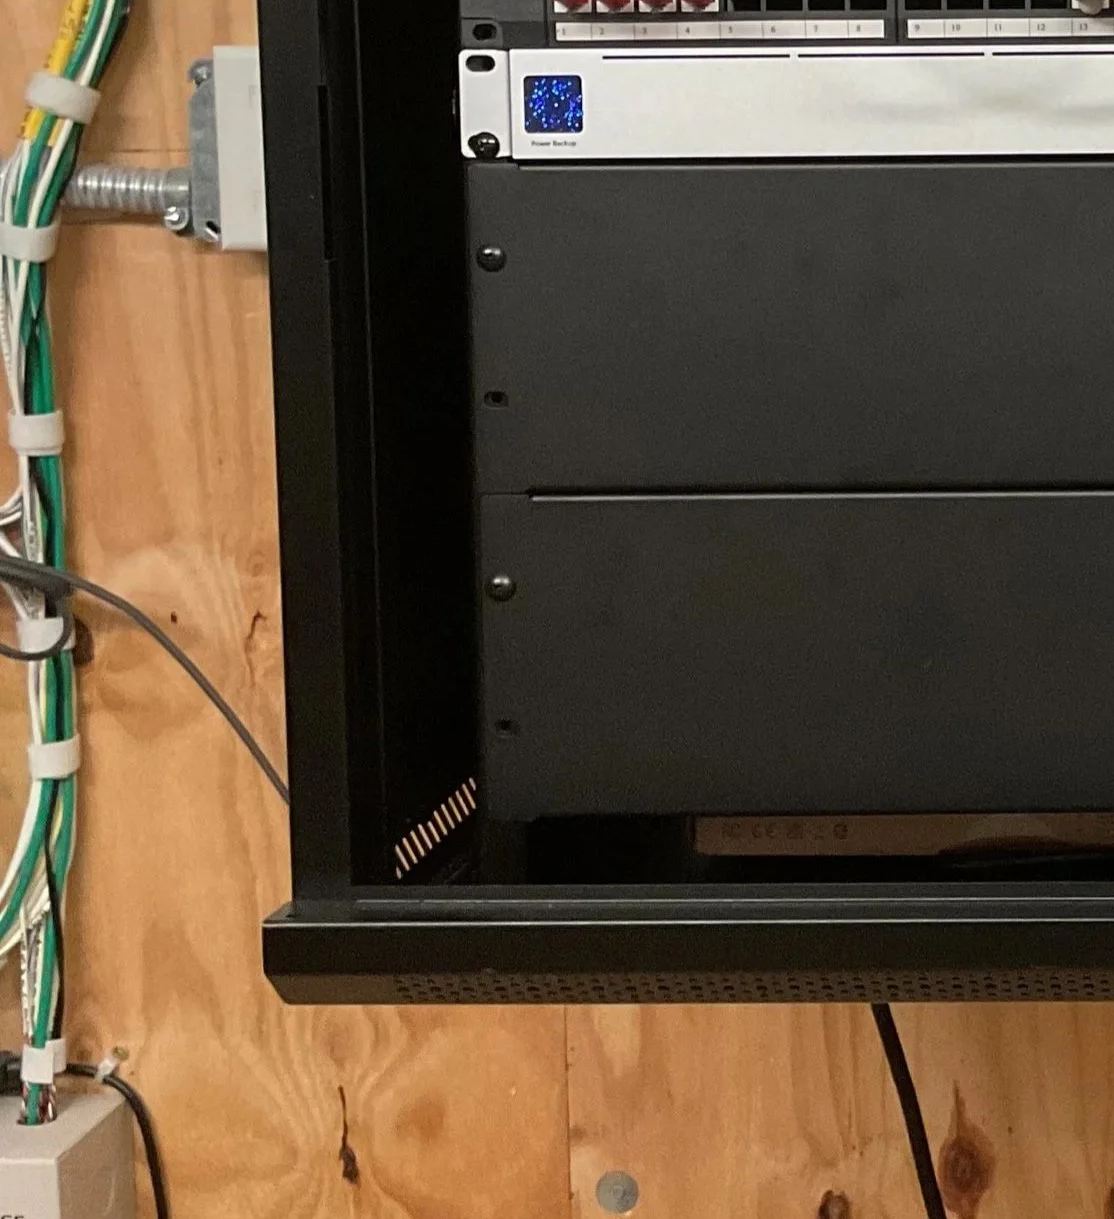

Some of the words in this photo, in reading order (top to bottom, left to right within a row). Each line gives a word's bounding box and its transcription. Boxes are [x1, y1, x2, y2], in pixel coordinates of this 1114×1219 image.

[914, 23, 920, 32] 9
[951, 23, 961, 32] 10
[994, 23, 1002, 31] 11
[1036, 23, 1046, 31] 12
